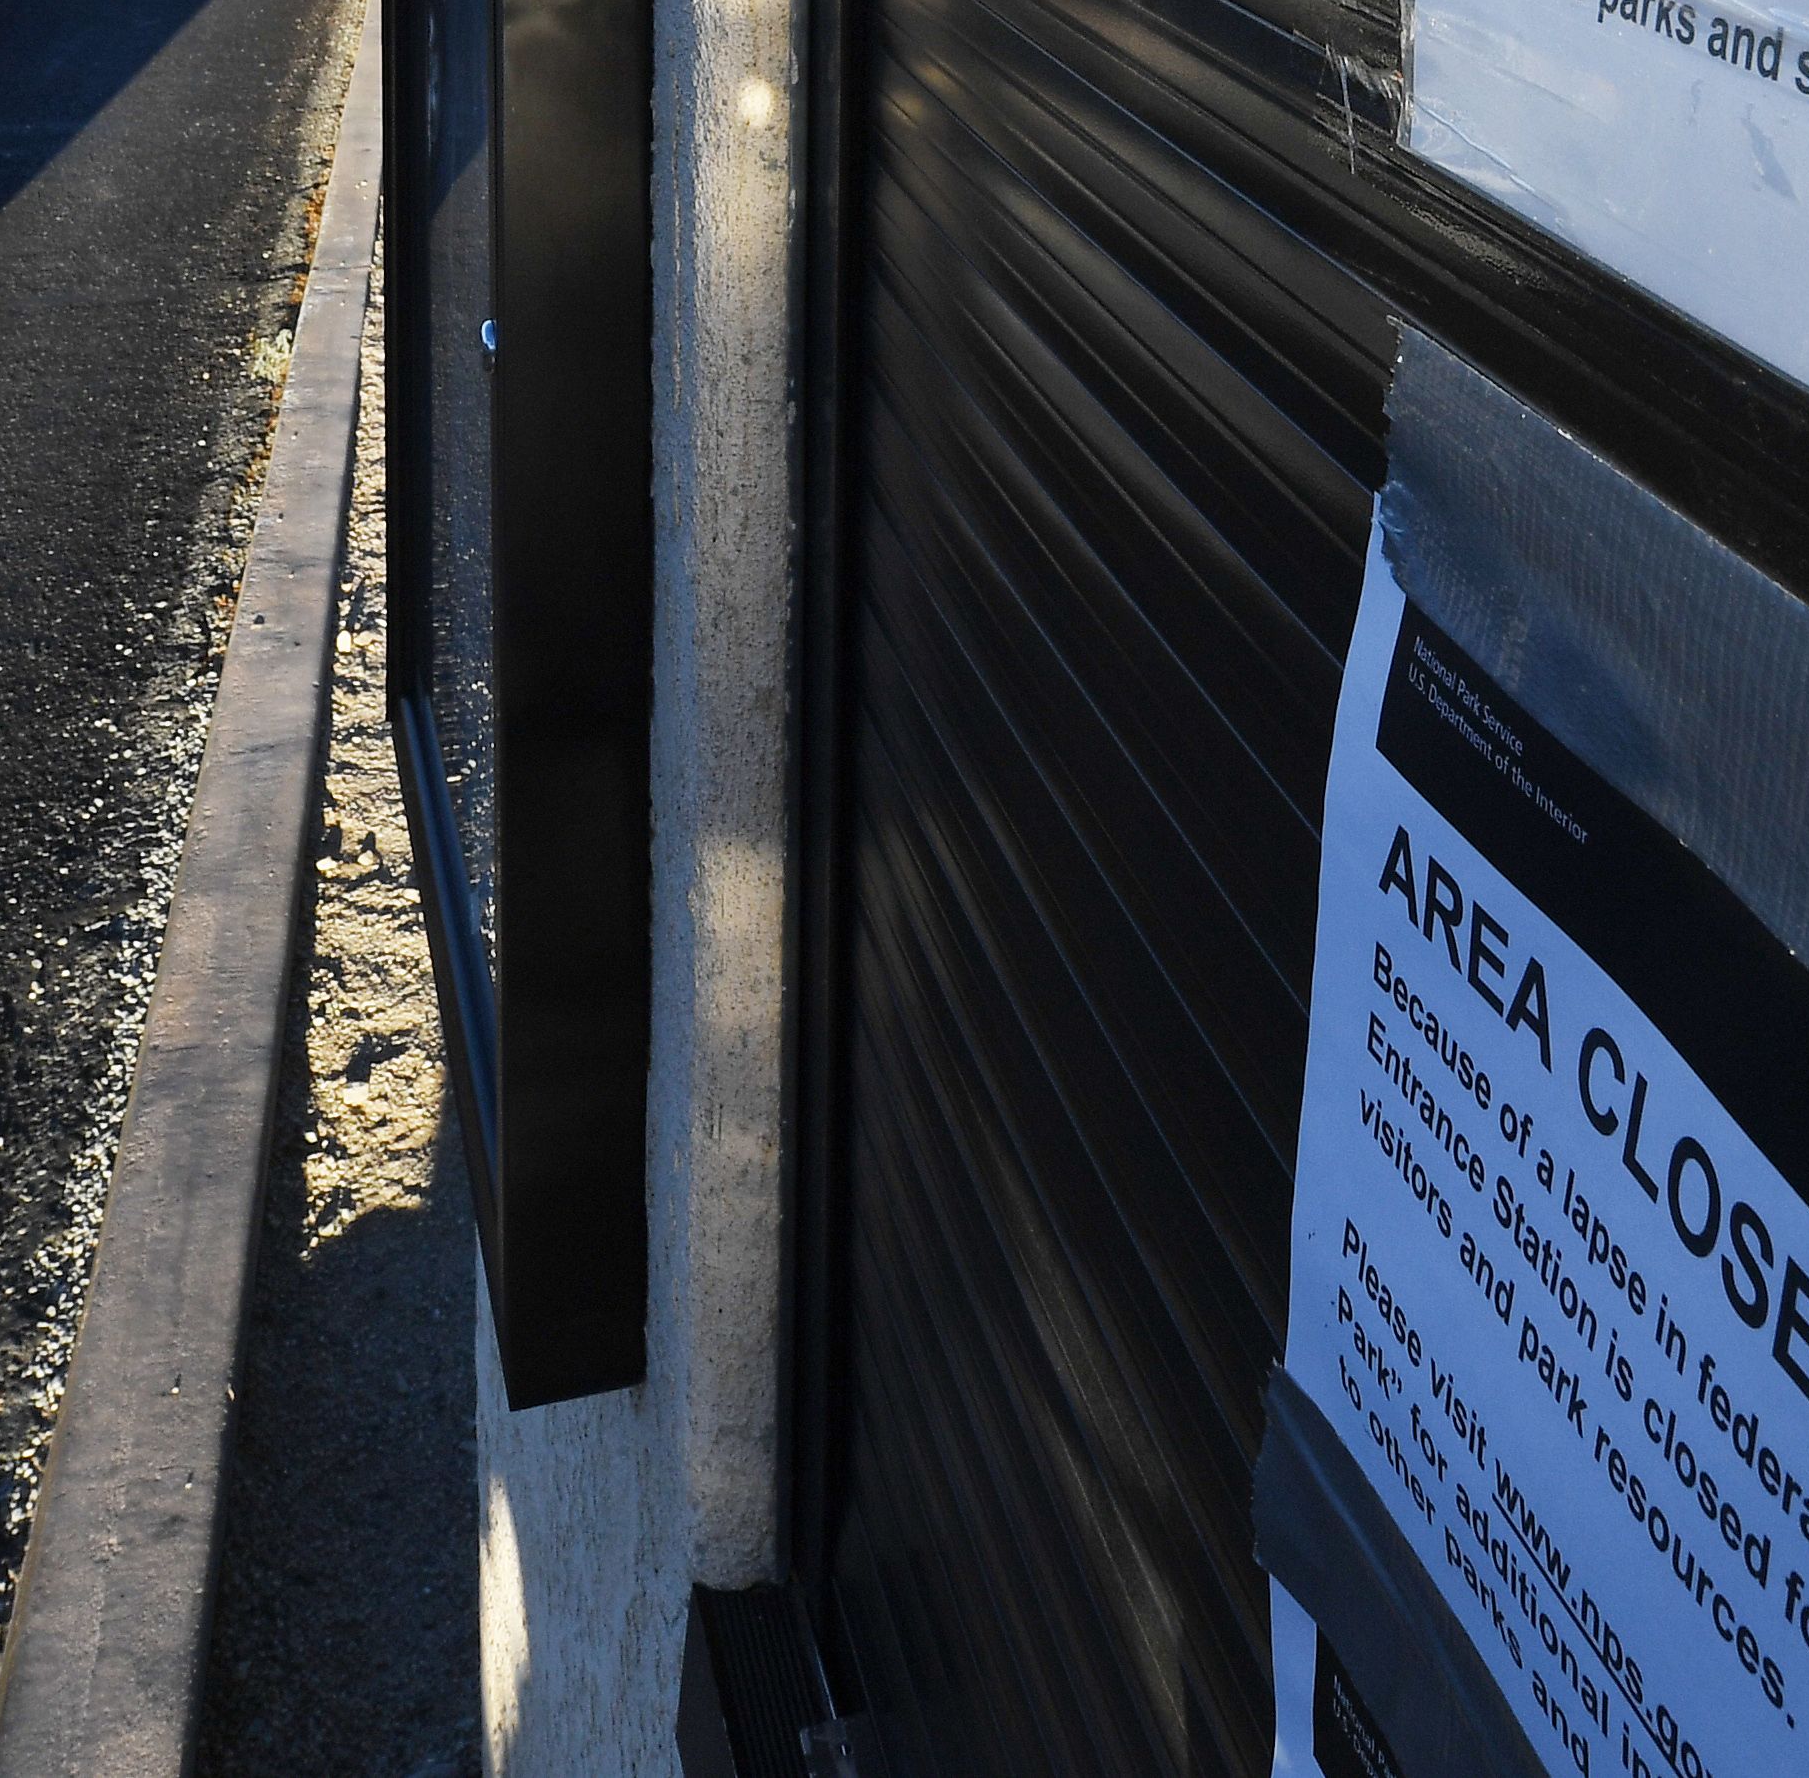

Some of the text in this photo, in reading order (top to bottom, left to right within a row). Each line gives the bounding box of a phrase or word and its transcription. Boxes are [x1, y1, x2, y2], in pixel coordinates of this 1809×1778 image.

[1706, 14, 1785, 82] and
[1408, 662, 1590, 846] U.S. Department of the Interior
[1412, 635, 1524, 757] National Park Service
[1377, 824, 1553, 1075] AREA
[1368, 1010, 1486, 1192] Entrance
[1492, 1175, 1598, 1352] Station
[1605, 1328, 1634, 1404] is
[1644, 1397, 1772, 1591] closed
[1372, 941, 1493, 1109] Because
[1499, 1101, 1534, 1159] of
[1536, 1147, 1555, 1196] a
[1562, 1168, 1648, 1317] lapse
[1654, 1294, 1688, 1377] in
[1338, 1354, 1591, 1778] to other parks and
[1342, 1217, 1713, 1778] Please visit www.nps.go
[1359, 1087, 1796, 1729] visitors and park resources.
[1410, 1405, 1448, 1483] for
[1455, 1483, 1611, 1739] additional
